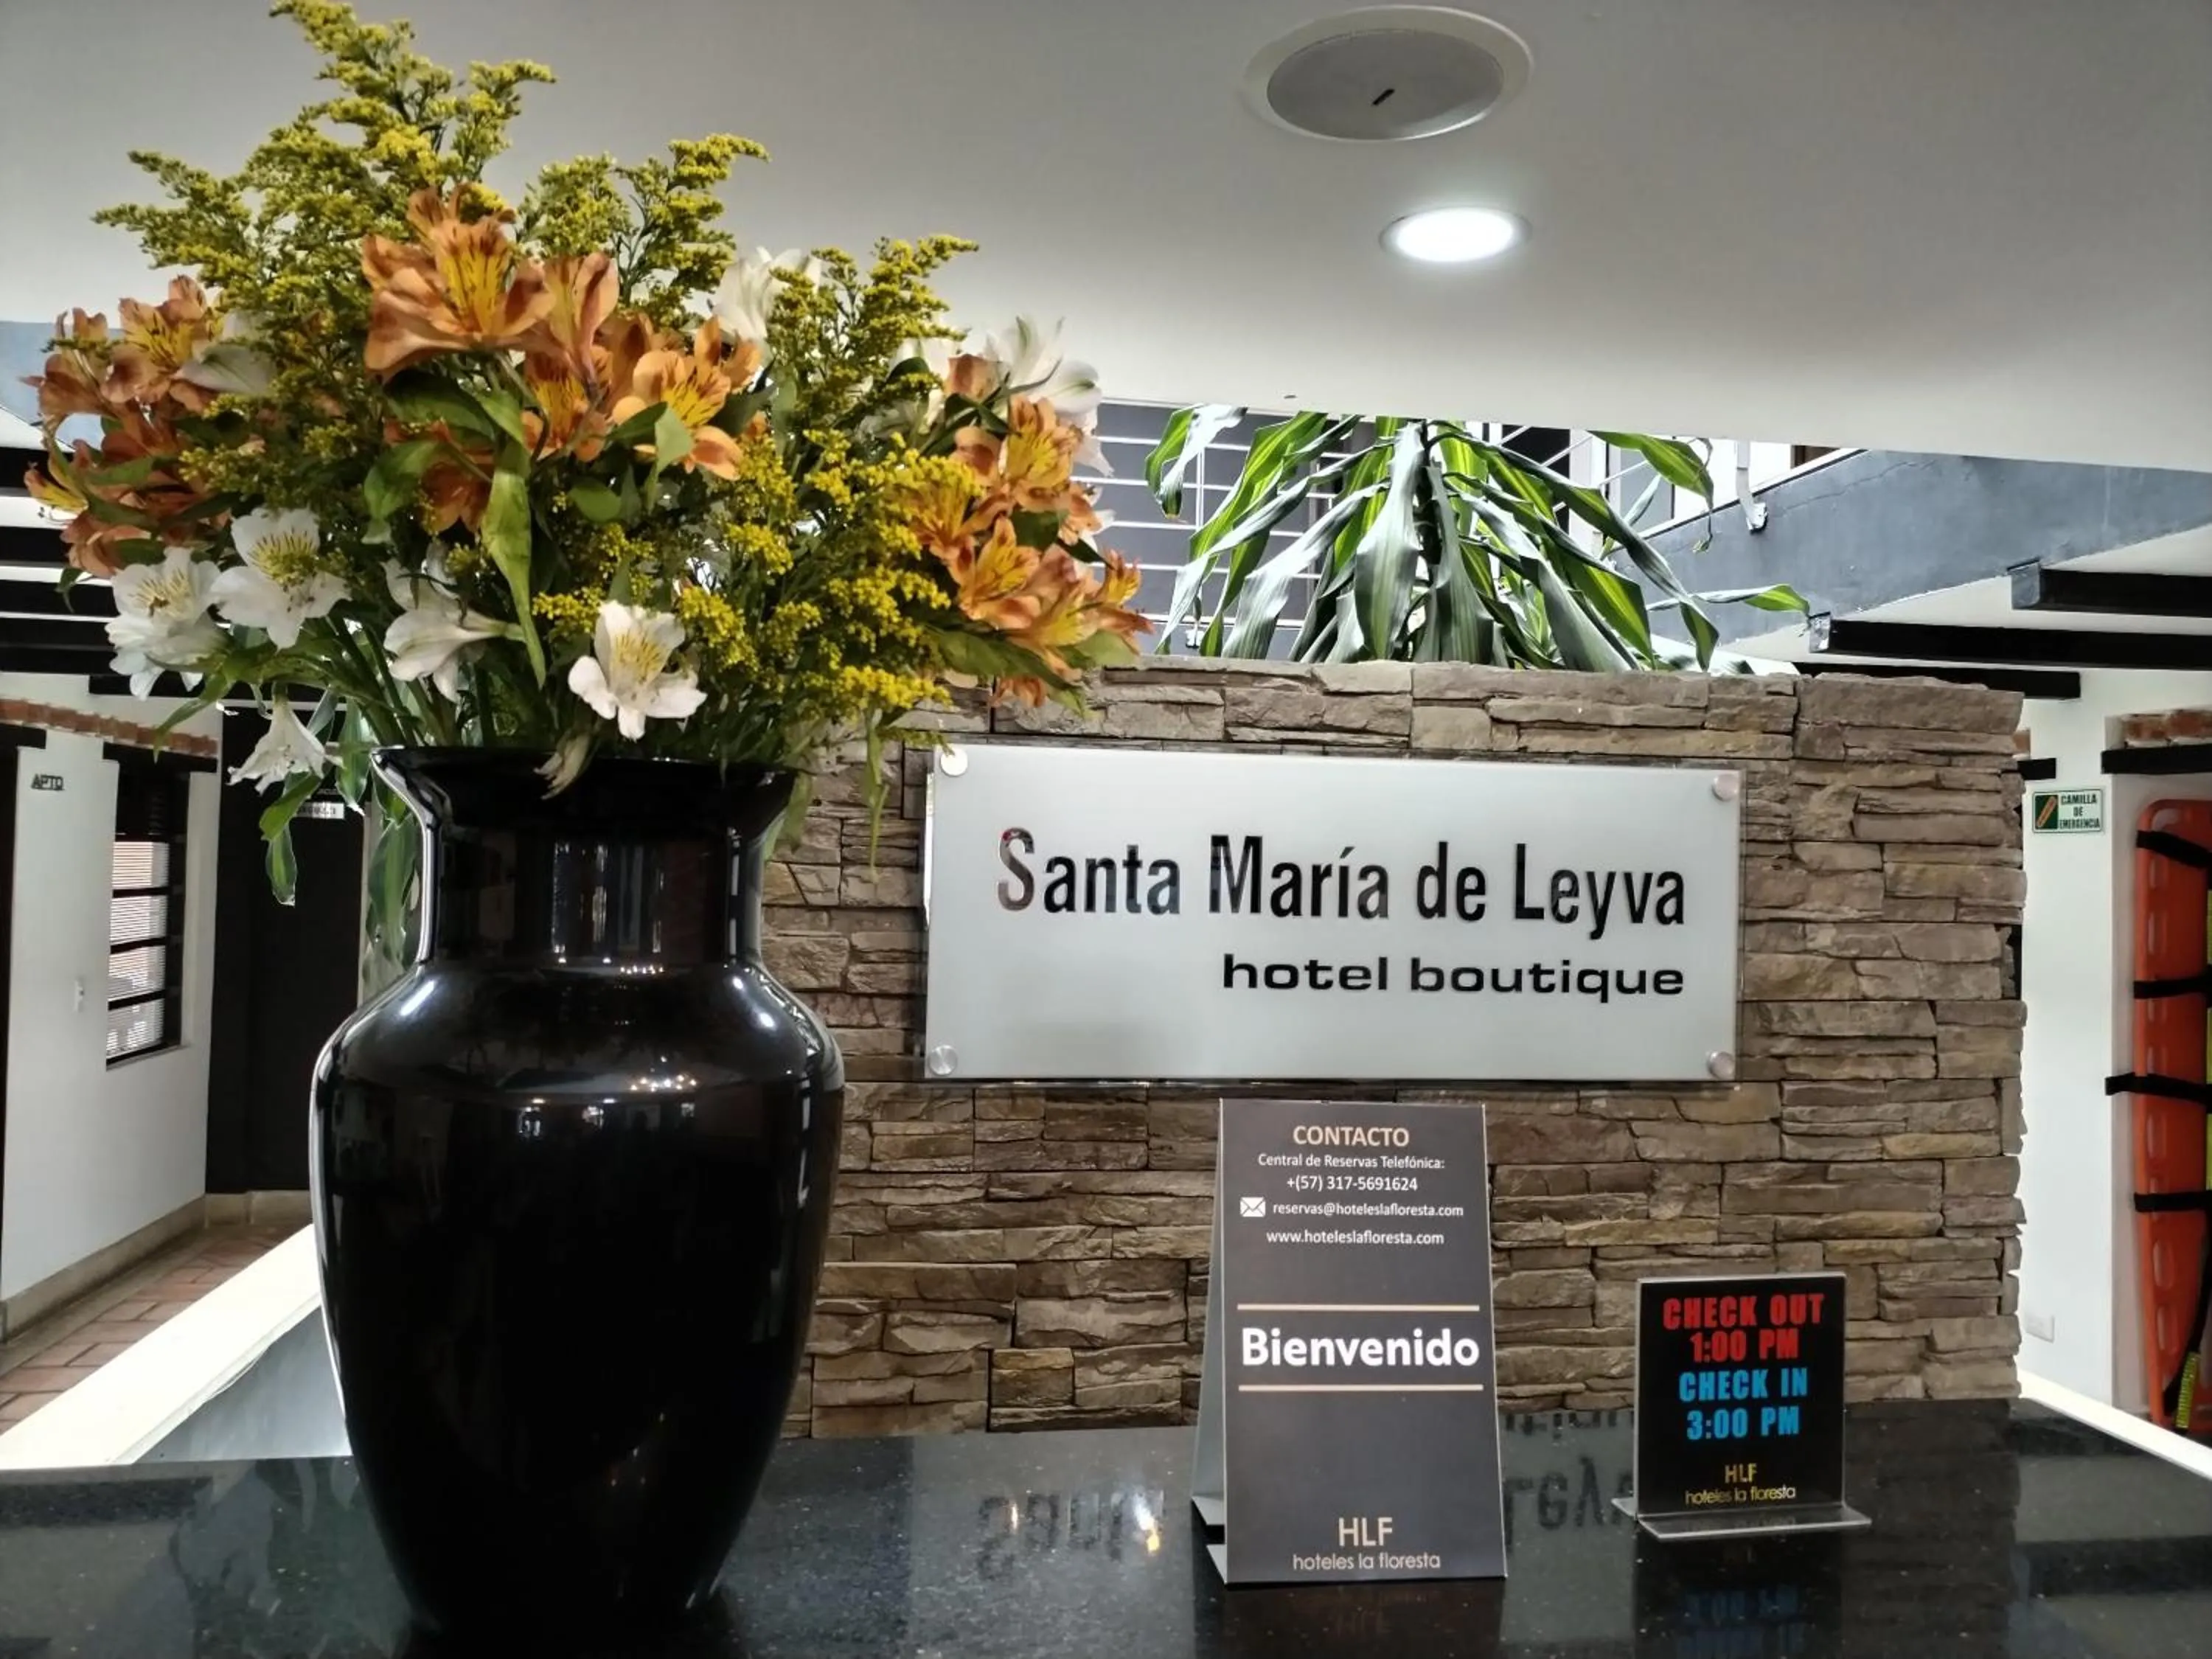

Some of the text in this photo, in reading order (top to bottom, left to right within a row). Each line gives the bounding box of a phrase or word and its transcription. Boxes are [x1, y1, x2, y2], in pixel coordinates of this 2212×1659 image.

[2061, 793, 2097, 804] CAMILLA
[2073, 806, 2083, 817] DE
[998, 827, 1686, 940] Santa María de Leyva
[1222, 954, 1686, 1004] hotel boutique
[1293, 1125, 1409, 1147] CONTACTO
[1258, 1153, 1445, 1169] Central de Reservas Telefónica:
[1287, 1175, 1418, 1192] +(57) 317-5691624
[1273, 1203, 1464, 1217] reservas@hoteleslafloresta.com
[1267, 1229, 1444, 1245] www.hoteleslafloresta.com
[1663, 1293, 1825, 1329] CHECK OUT
[1242, 1327, 1480, 1366] Bienvenido
[1690, 1329, 1799, 1363] 1:00 PM
[1679, 1368, 1808, 1402] CHECK IN
[1687, 1406, 1799, 1439] 3:00 PM
[1725, 1463, 1757, 1484] HLF
[1685, 1484, 1796, 1505] hoteles la floresta
[1338, 1517, 1393, 1547] HLF
[1293, 1551, 1440, 1571] hoteles la floresta
